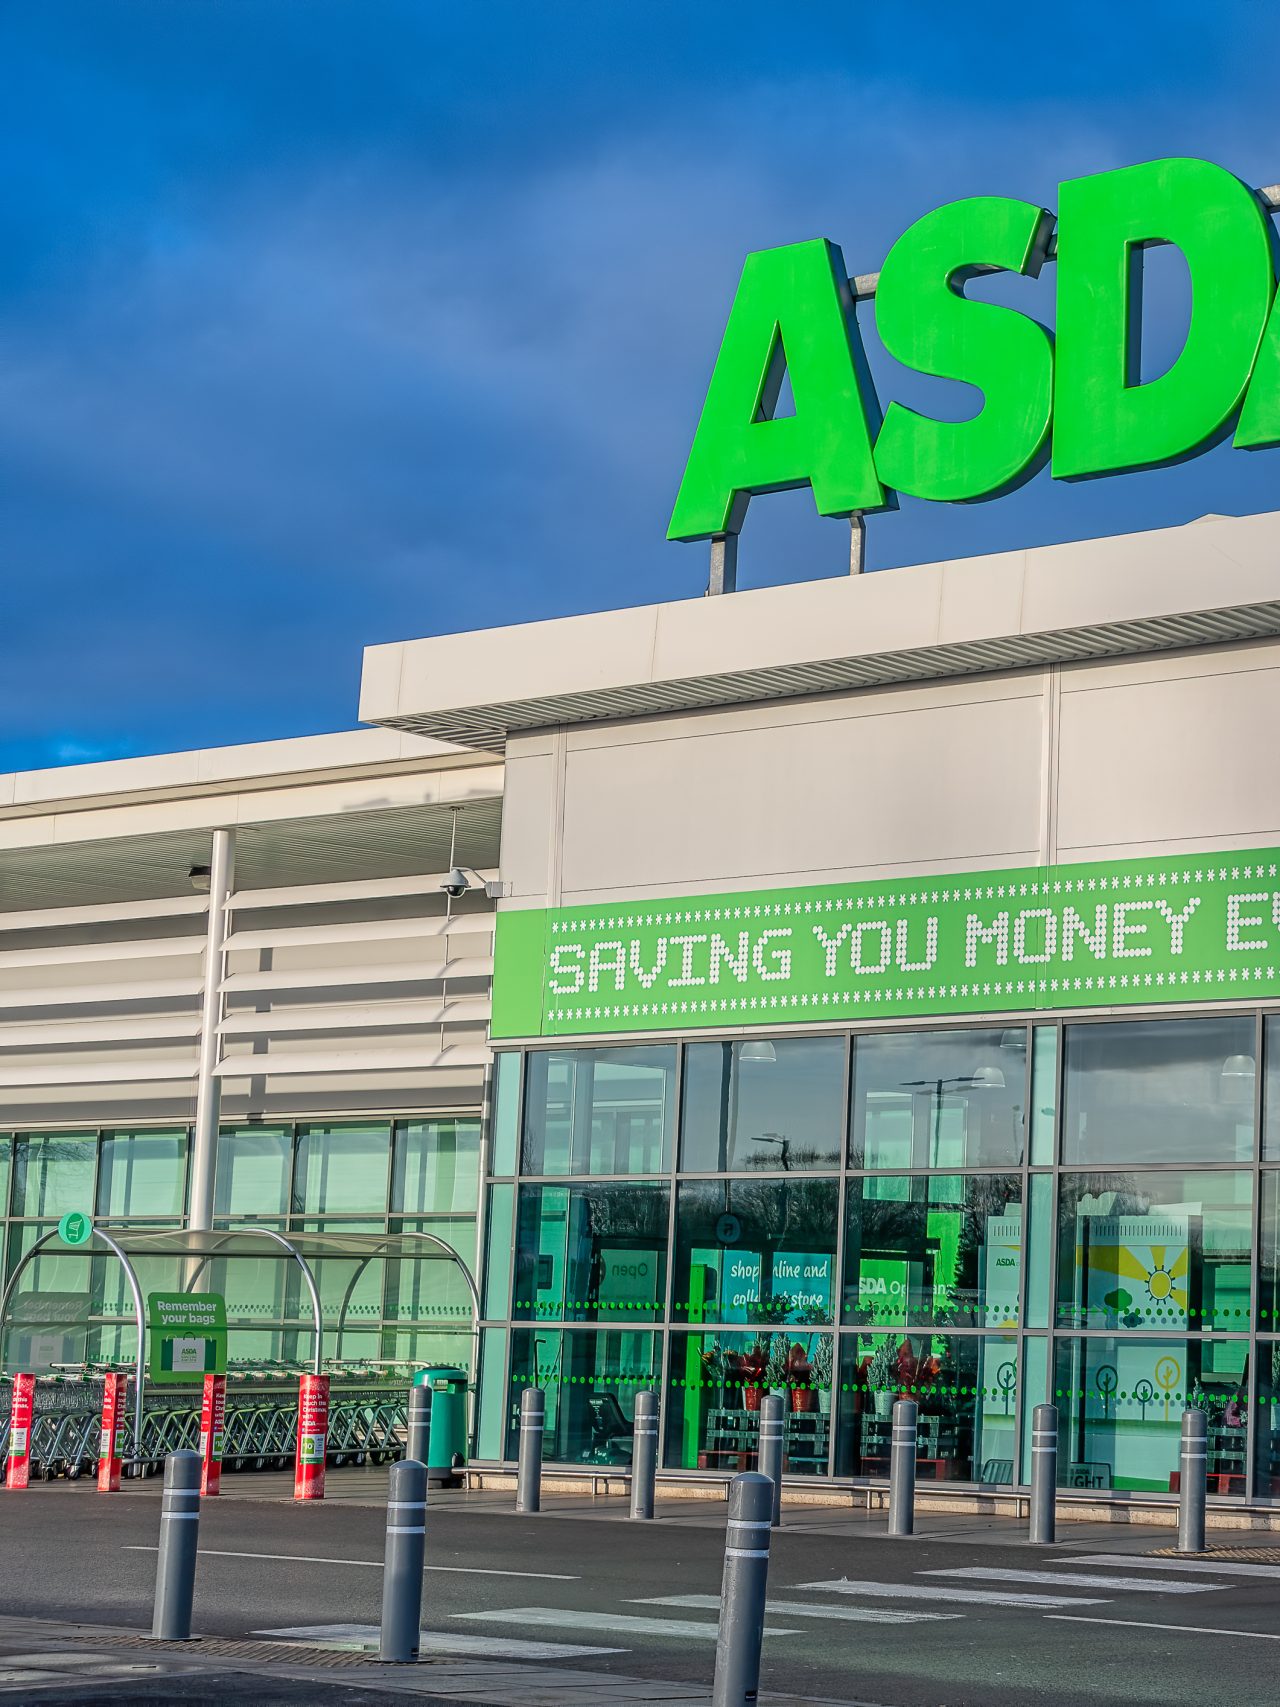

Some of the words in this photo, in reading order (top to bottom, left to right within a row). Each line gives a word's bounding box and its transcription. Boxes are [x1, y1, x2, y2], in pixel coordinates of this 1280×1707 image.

[549, 928, 793, 995] SAVING
[812, 916, 938, 977] YOU
[965, 897, 1201, 968] MONEY
[995, 1258, 1016, 1267] ASDA
[730, 1260, 760, 1283] shop
[772, 1260, 801, 1279] nline
[803, 1260, 828, 1278] and
[859, 1277, 887, 1295] SDA
[157, 1301, 217, 1312] Remember
[791, 1290, 823, 1310] store
[161, 1314, 187, 1325] your
[189, 1313, 216, 1325] bags
[1074, 1475, 1105, 1488] GHT
